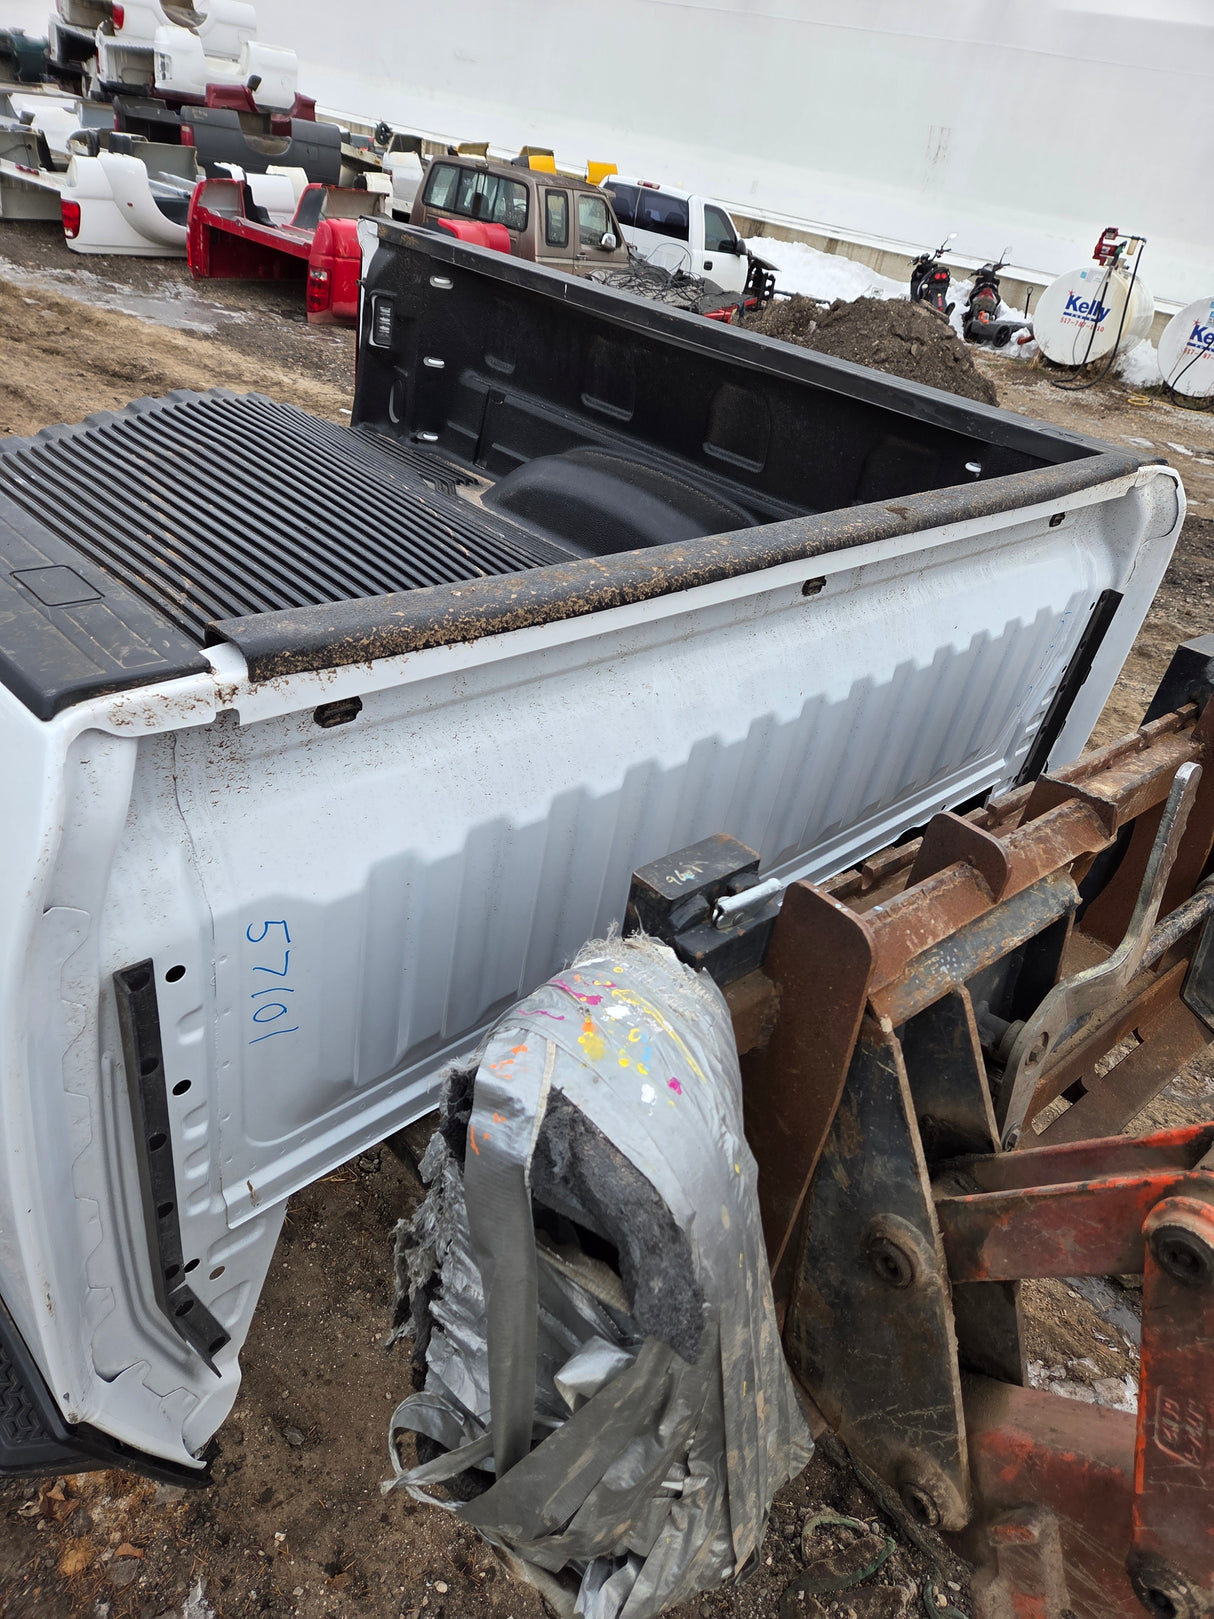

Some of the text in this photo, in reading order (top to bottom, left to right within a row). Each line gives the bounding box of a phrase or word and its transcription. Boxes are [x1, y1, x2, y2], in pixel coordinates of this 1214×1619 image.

[1065, 294, 1111, 322] Kelly
[1060, 316, 1105, 333] 517-787-110
[246, 919, 300, 1045] 57101
